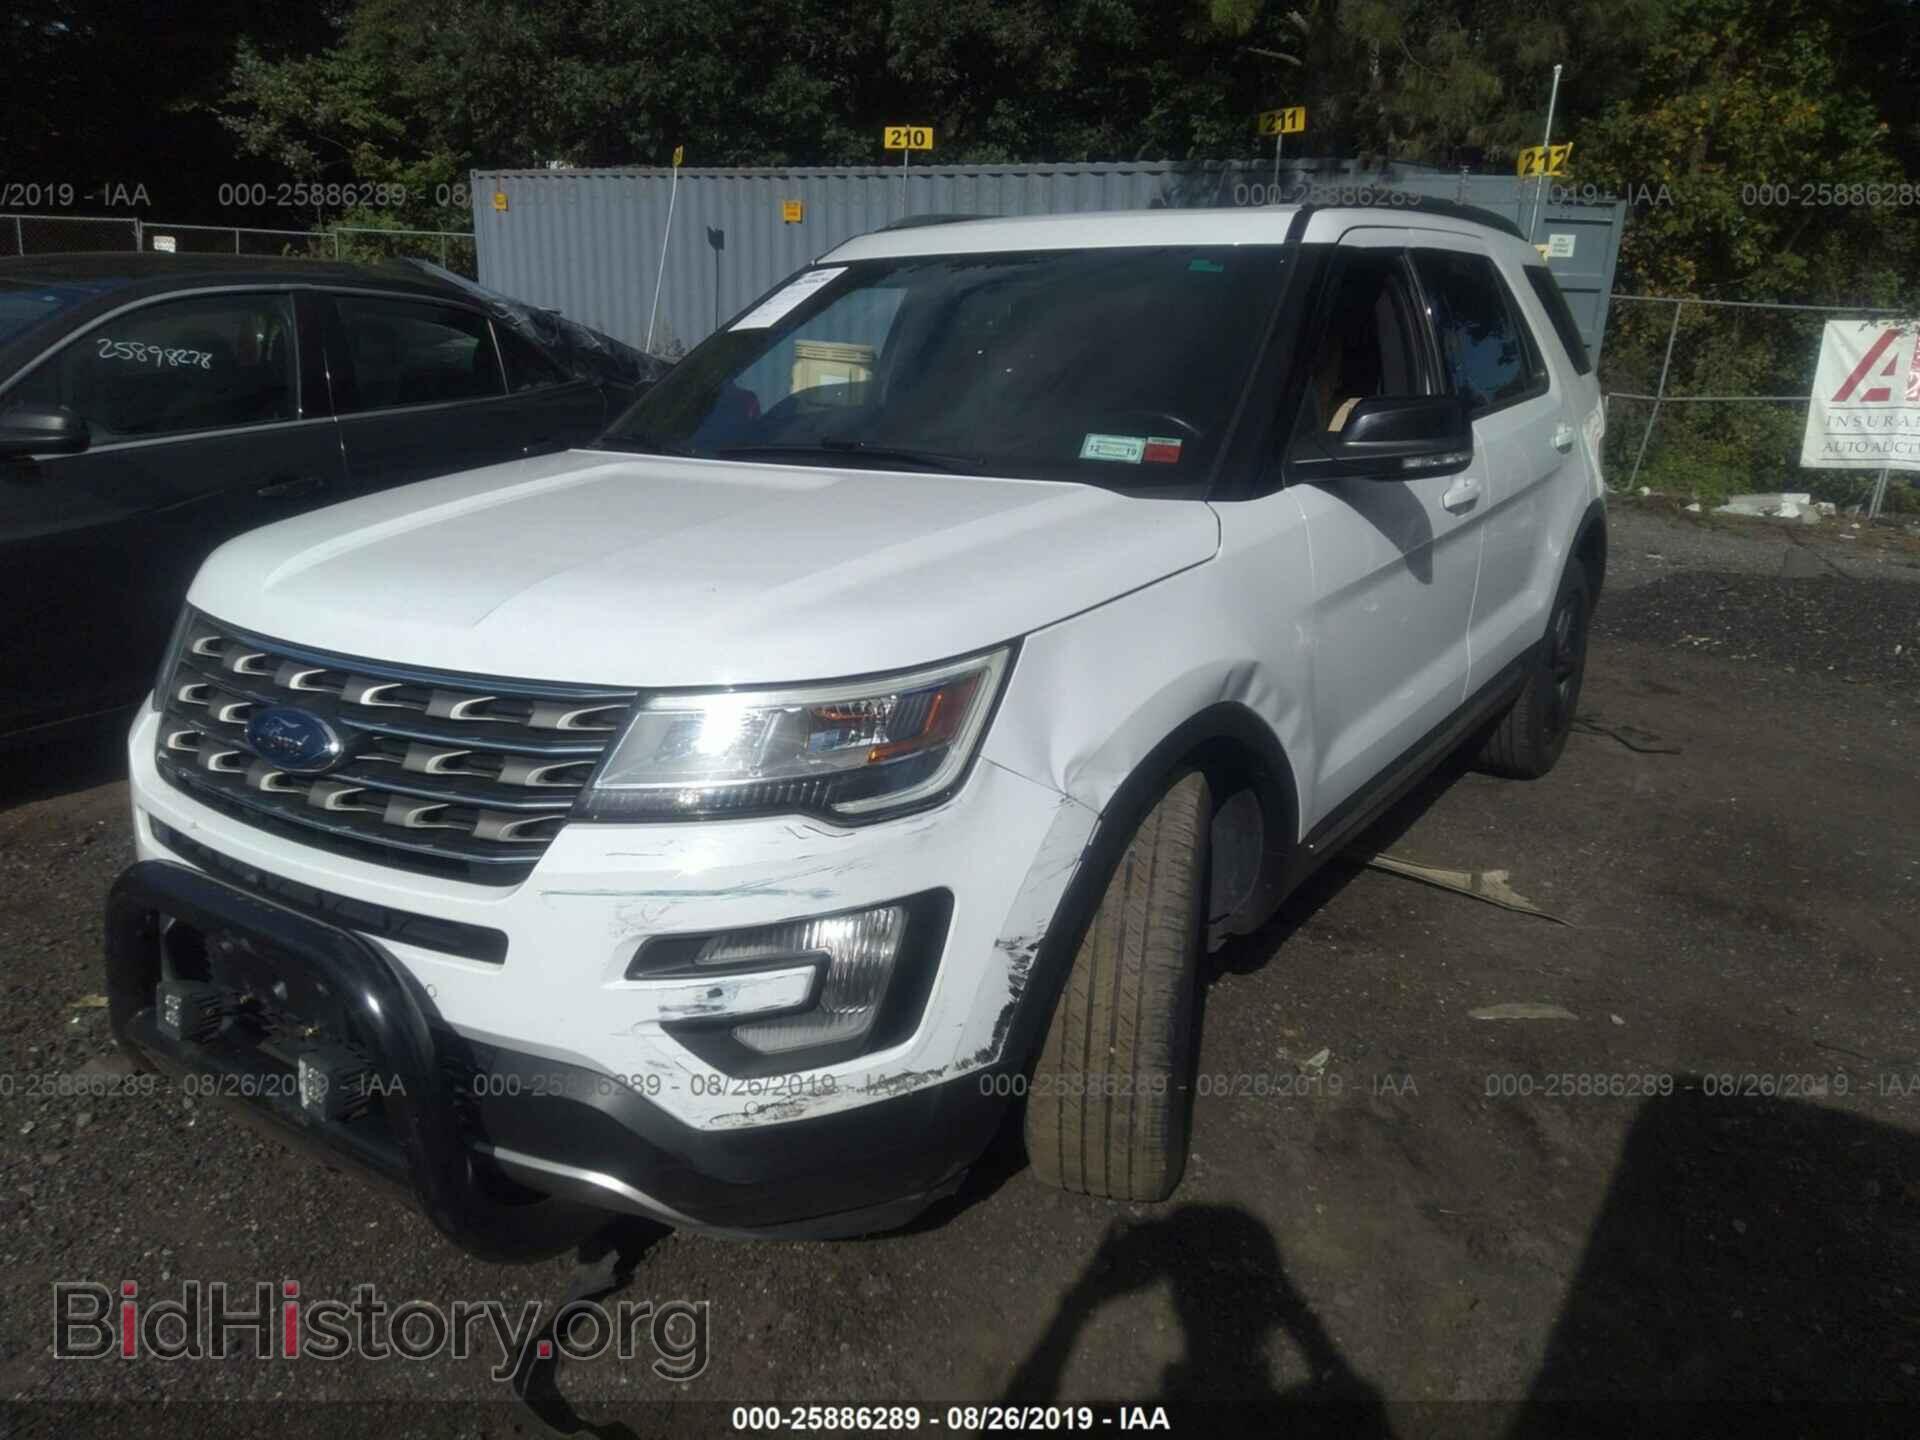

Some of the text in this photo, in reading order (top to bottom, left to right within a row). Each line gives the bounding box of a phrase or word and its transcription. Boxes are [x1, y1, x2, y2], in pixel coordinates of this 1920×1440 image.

[1265, 110, 1297, 133] 211
[890, 129, 925, 148] 210
[1524, 149, 1568, 174] 212
[1823, 415, 1920, 428] INSURA
